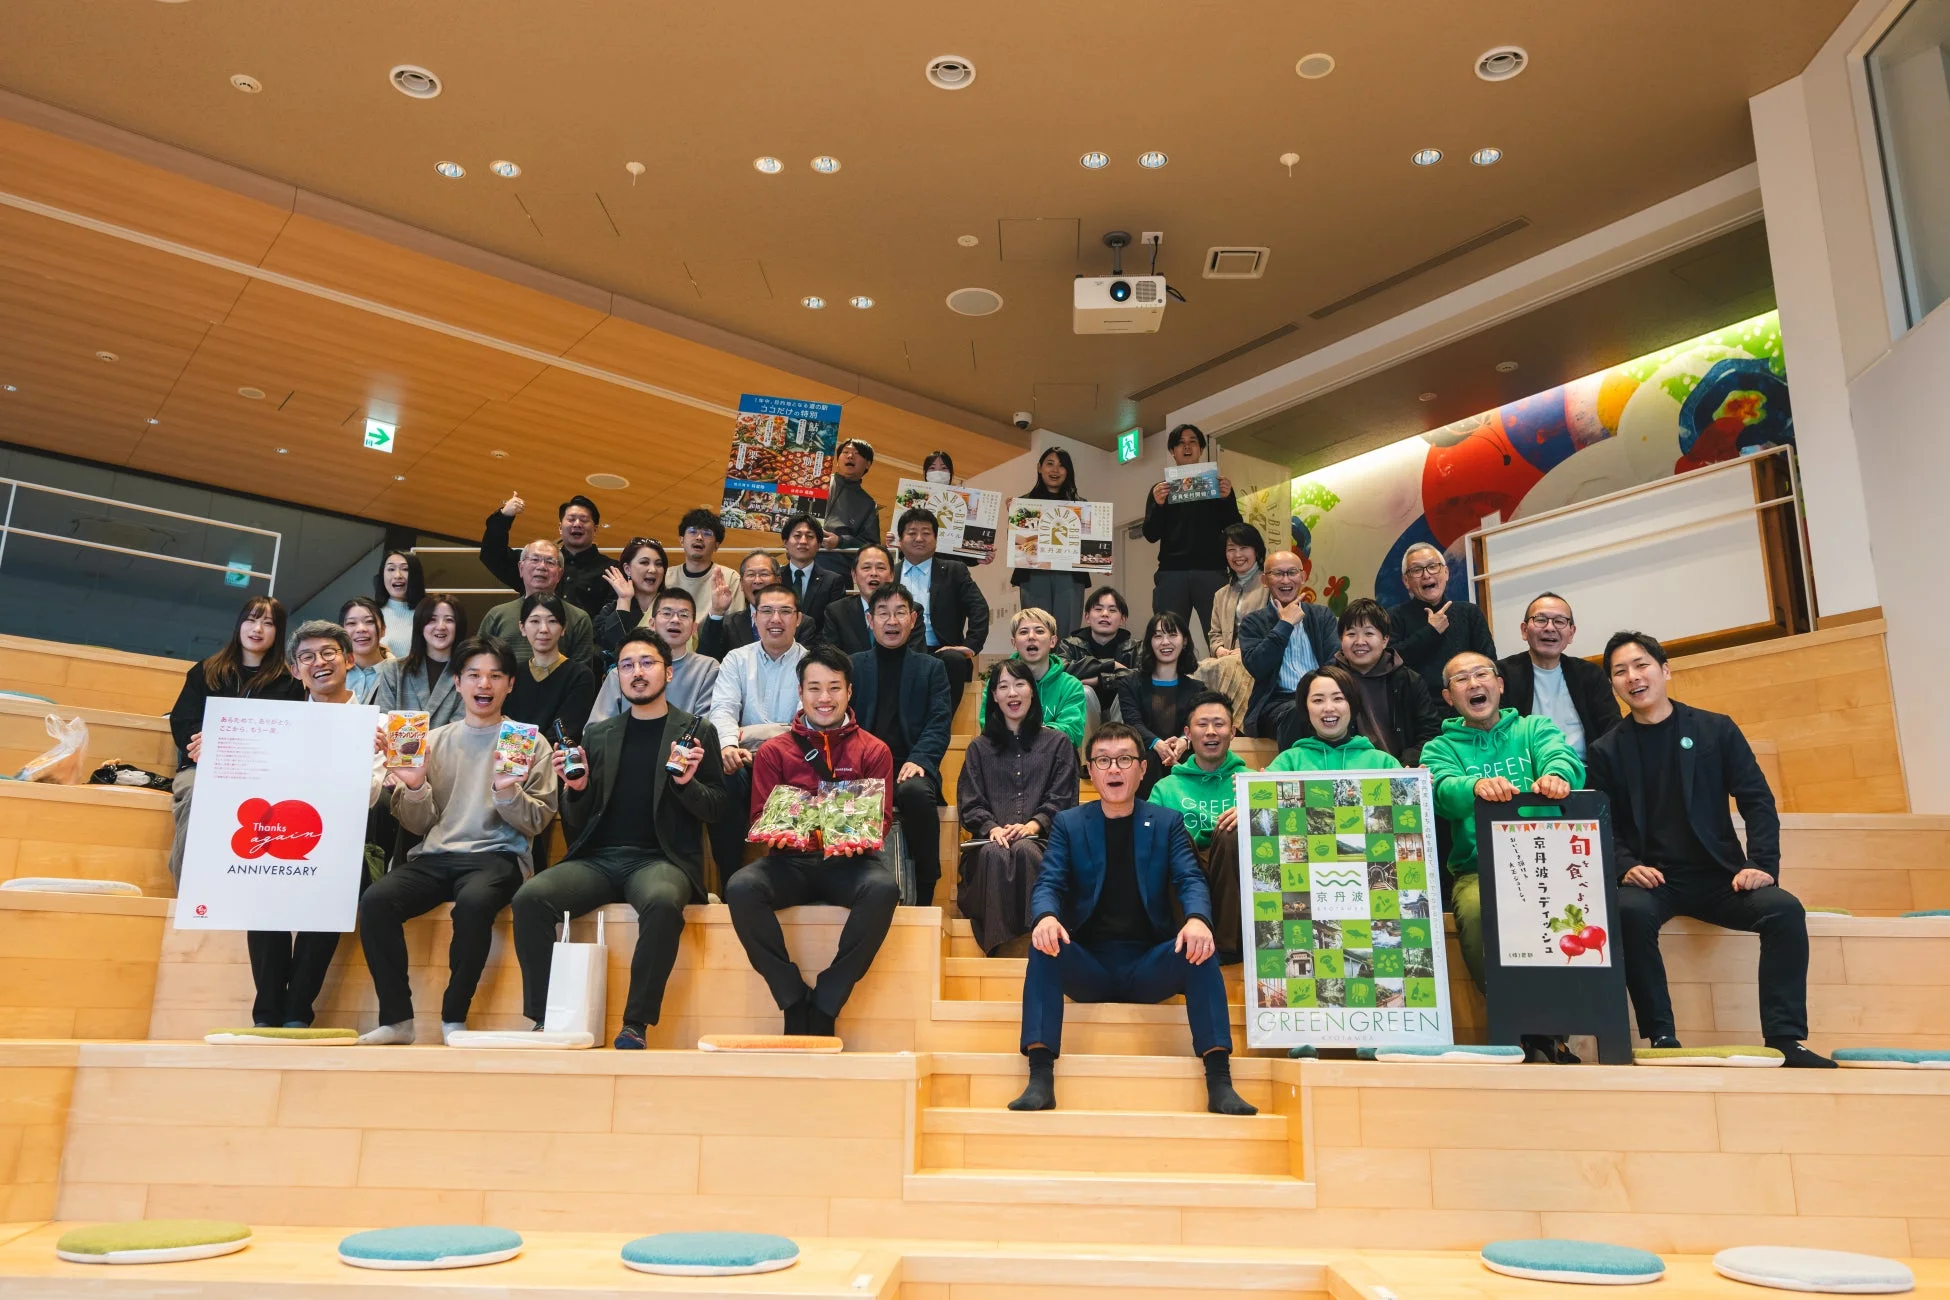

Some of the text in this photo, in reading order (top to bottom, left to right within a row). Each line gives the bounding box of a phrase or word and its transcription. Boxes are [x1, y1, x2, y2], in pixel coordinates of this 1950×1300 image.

[760, 404, 818, 419] ココだけの特別
[1465, 748, 1532, 779] GREEN
[253, 822, 287, 832] Thanks
[249, 832, 322, 854] again
[227, 864, 318, 876] ANNIVERSARY
[1315, 891, 1364, 902] 京丹波
[1533, 836, 1554, 954] 京丹波ラディッシュ
[1257, 1011, 1440, 1032] GREENGREEN
